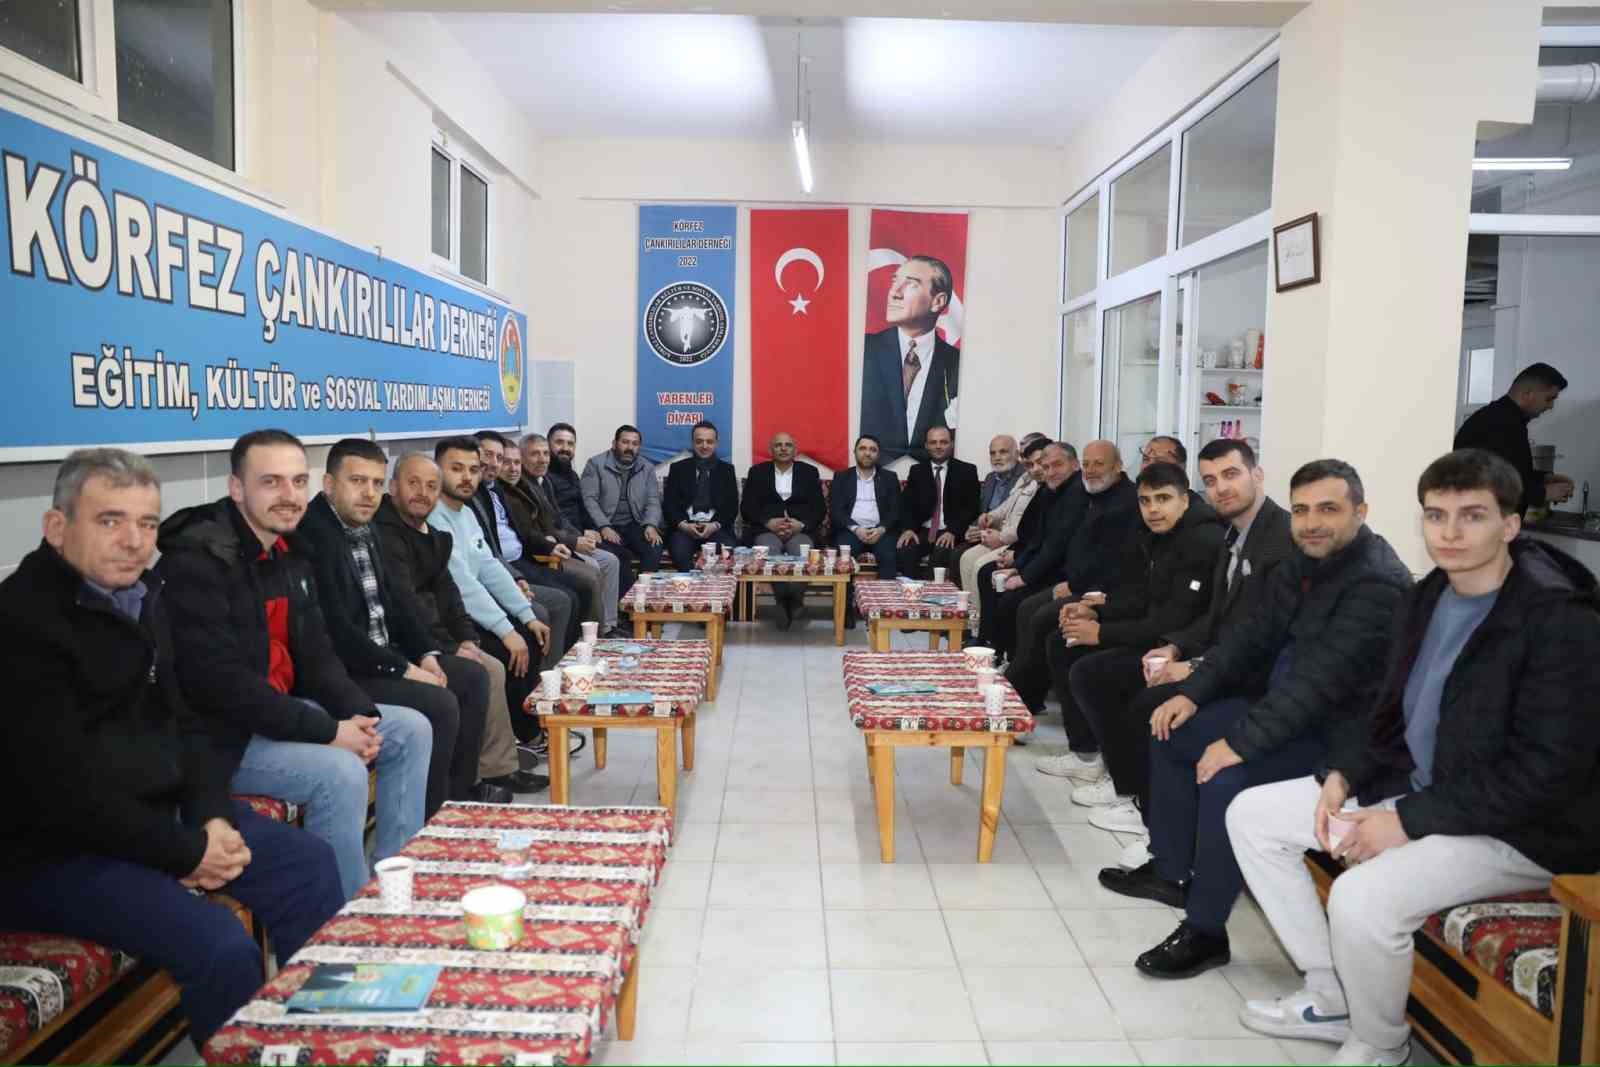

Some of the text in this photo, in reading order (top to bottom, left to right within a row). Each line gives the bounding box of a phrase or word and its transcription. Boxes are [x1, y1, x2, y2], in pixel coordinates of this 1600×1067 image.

[672, 219, 705, 233] KÖRFEZ
[2, 149, 498, 362] KÖRFEZ ÇANKIRILILAR DERNEĞİ
[679, 256, 698, 268] 2022
[71, 344, 492, 420] EĞİTİM, KÜLTÜR ve SOSYAL YARDIMLAŞMA DERNEĞİ
[657, 392, 713, 405] YARENLER
[667, 409, 704, 425] DİYARI
